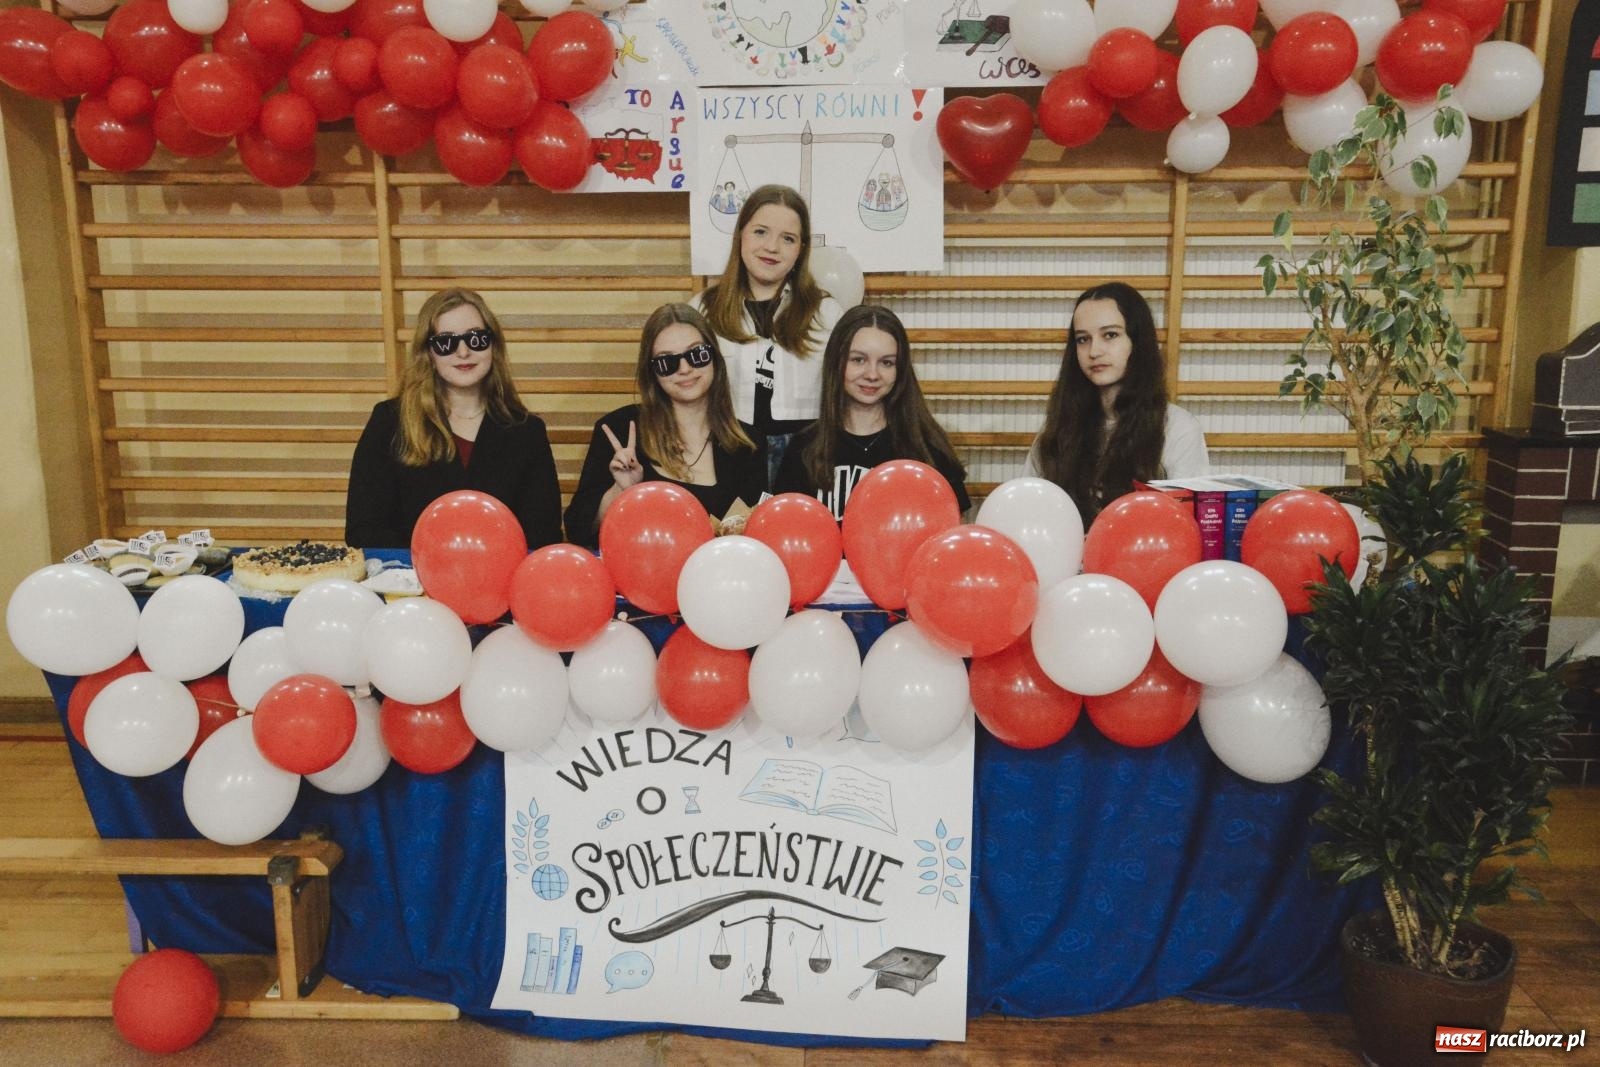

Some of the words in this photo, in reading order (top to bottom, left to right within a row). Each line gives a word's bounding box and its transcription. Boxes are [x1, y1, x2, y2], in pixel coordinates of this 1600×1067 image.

[624, 88, 652, 108] TO
[703, 94, 804, 120] WSZYSCY
[815, 91, 899, 119] RÓWNI
[556, 727, 732, 793] WIEDZA
[636, 786, 667, 815] O
[571, 823, 904, 913] SPOŁECZEŃSTWIE
